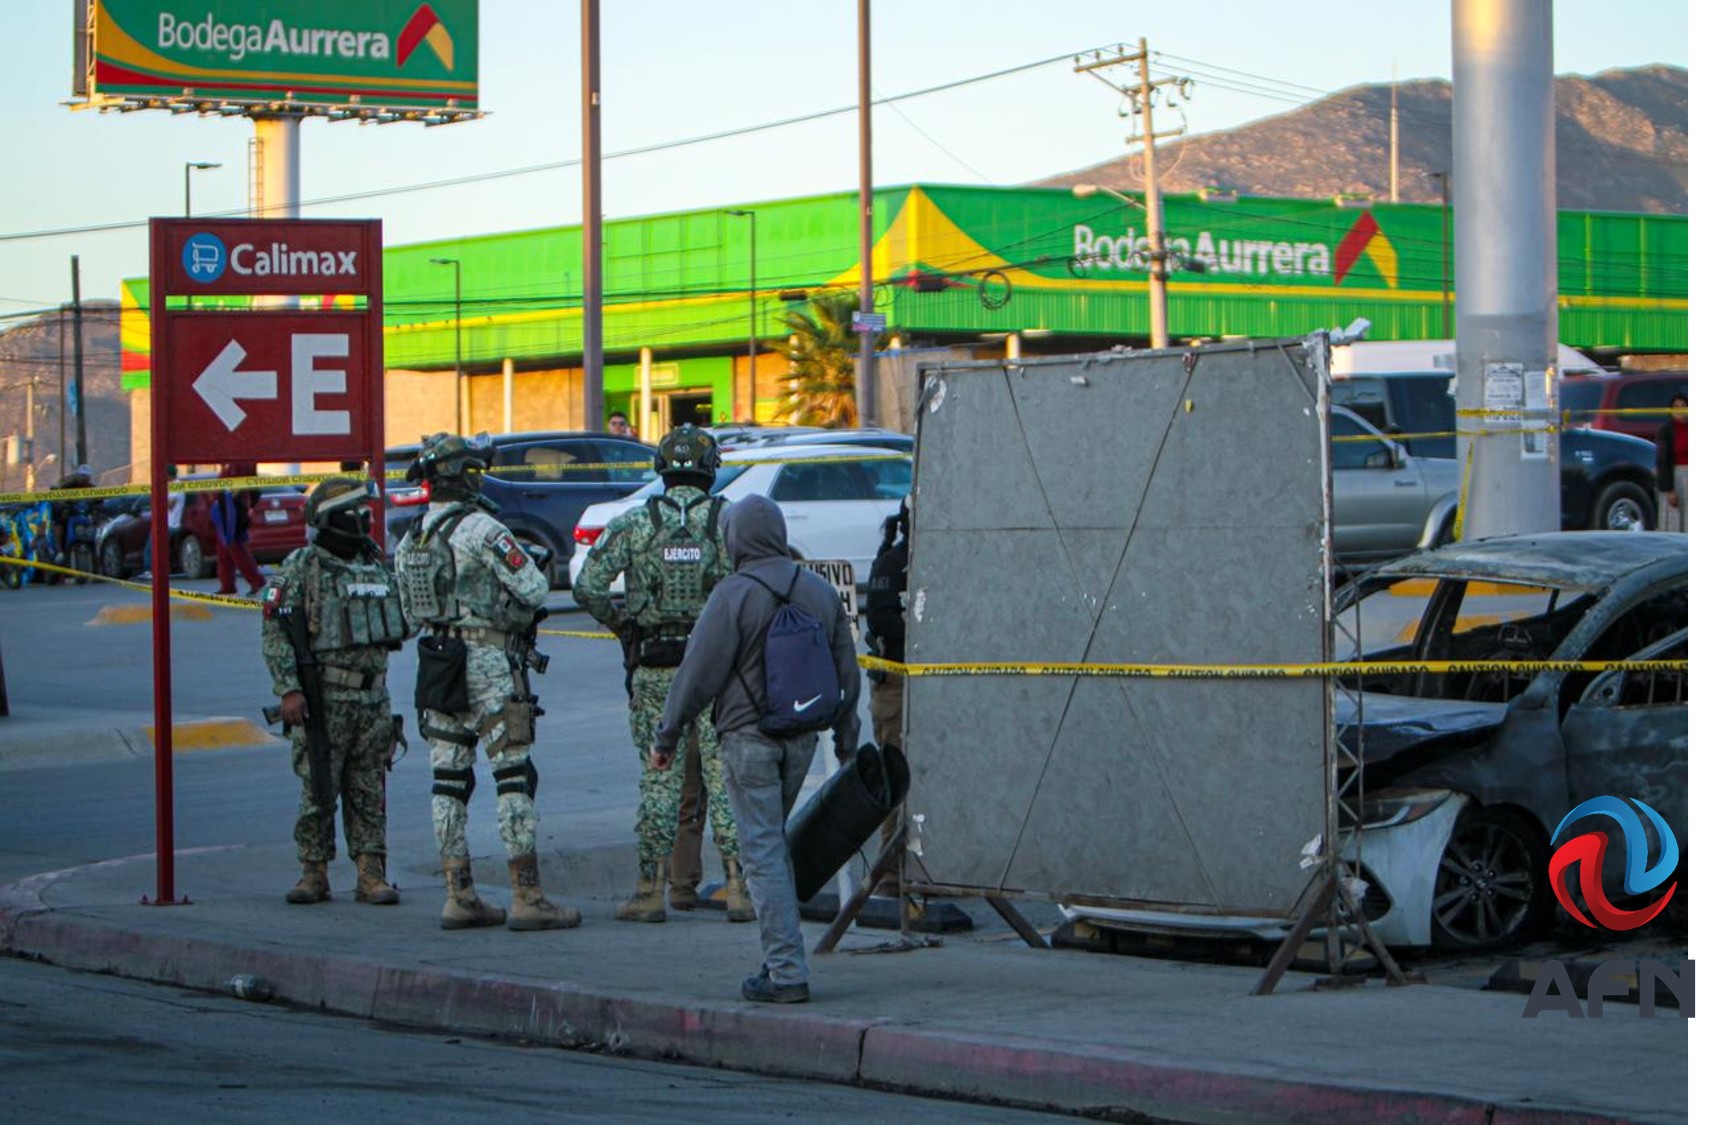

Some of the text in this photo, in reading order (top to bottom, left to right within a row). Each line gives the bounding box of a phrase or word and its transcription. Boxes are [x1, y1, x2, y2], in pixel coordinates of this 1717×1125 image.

[158, 12, 389, 60] BodegaAurrera
[231, 242, 357, 276] Calimax
[291, 333, 351, 436] E
